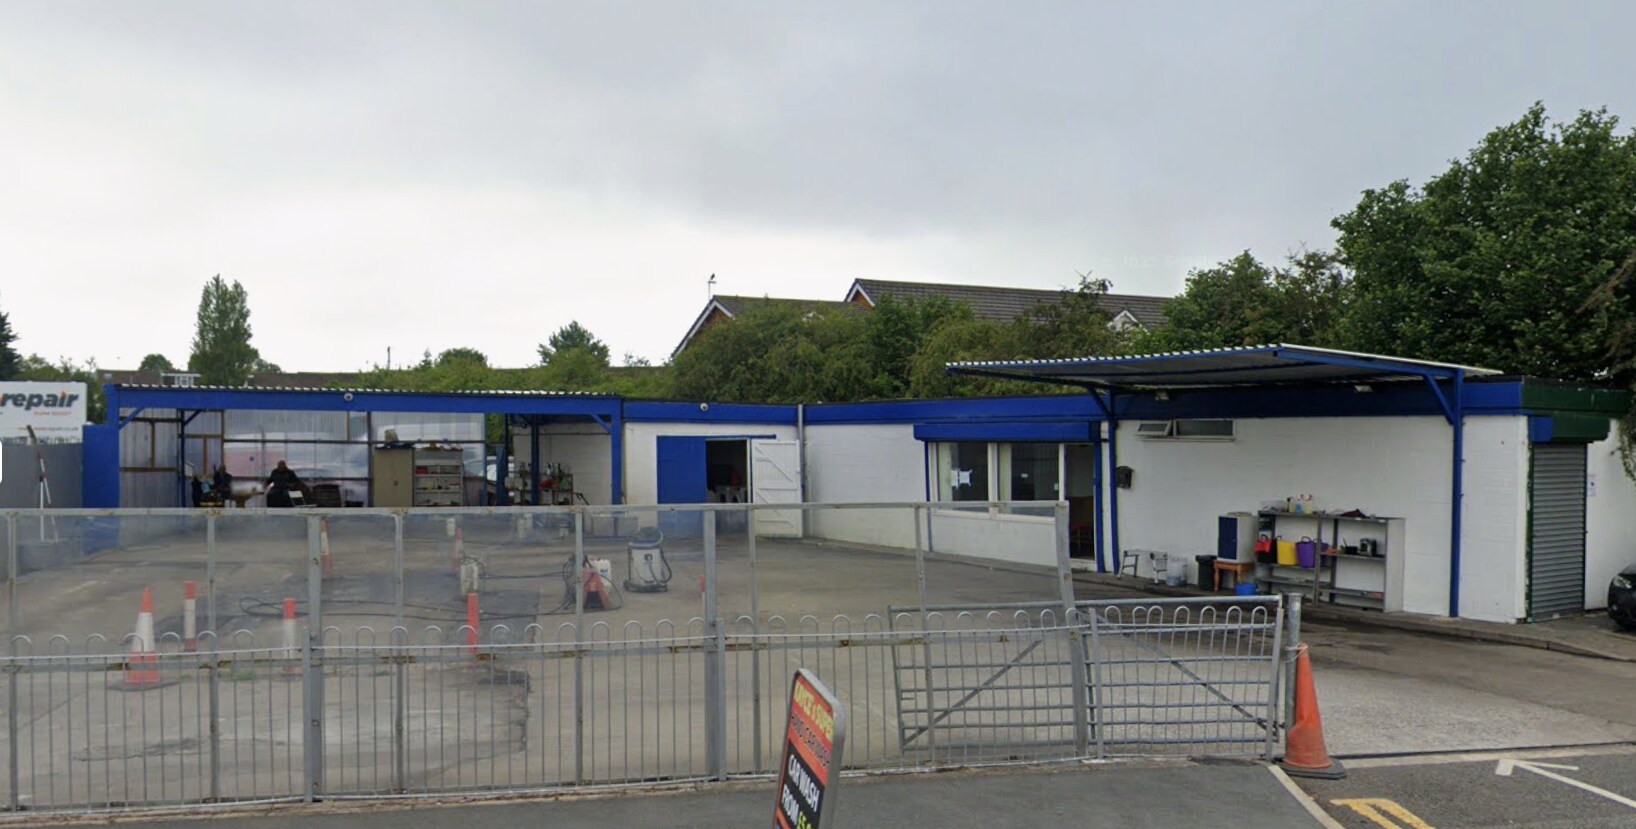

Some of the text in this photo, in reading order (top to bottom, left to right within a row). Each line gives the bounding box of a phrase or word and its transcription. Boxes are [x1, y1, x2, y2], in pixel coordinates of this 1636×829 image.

[781, 783, 800, 827] FROM
[788, 754, 820, 813] CAR WASH
